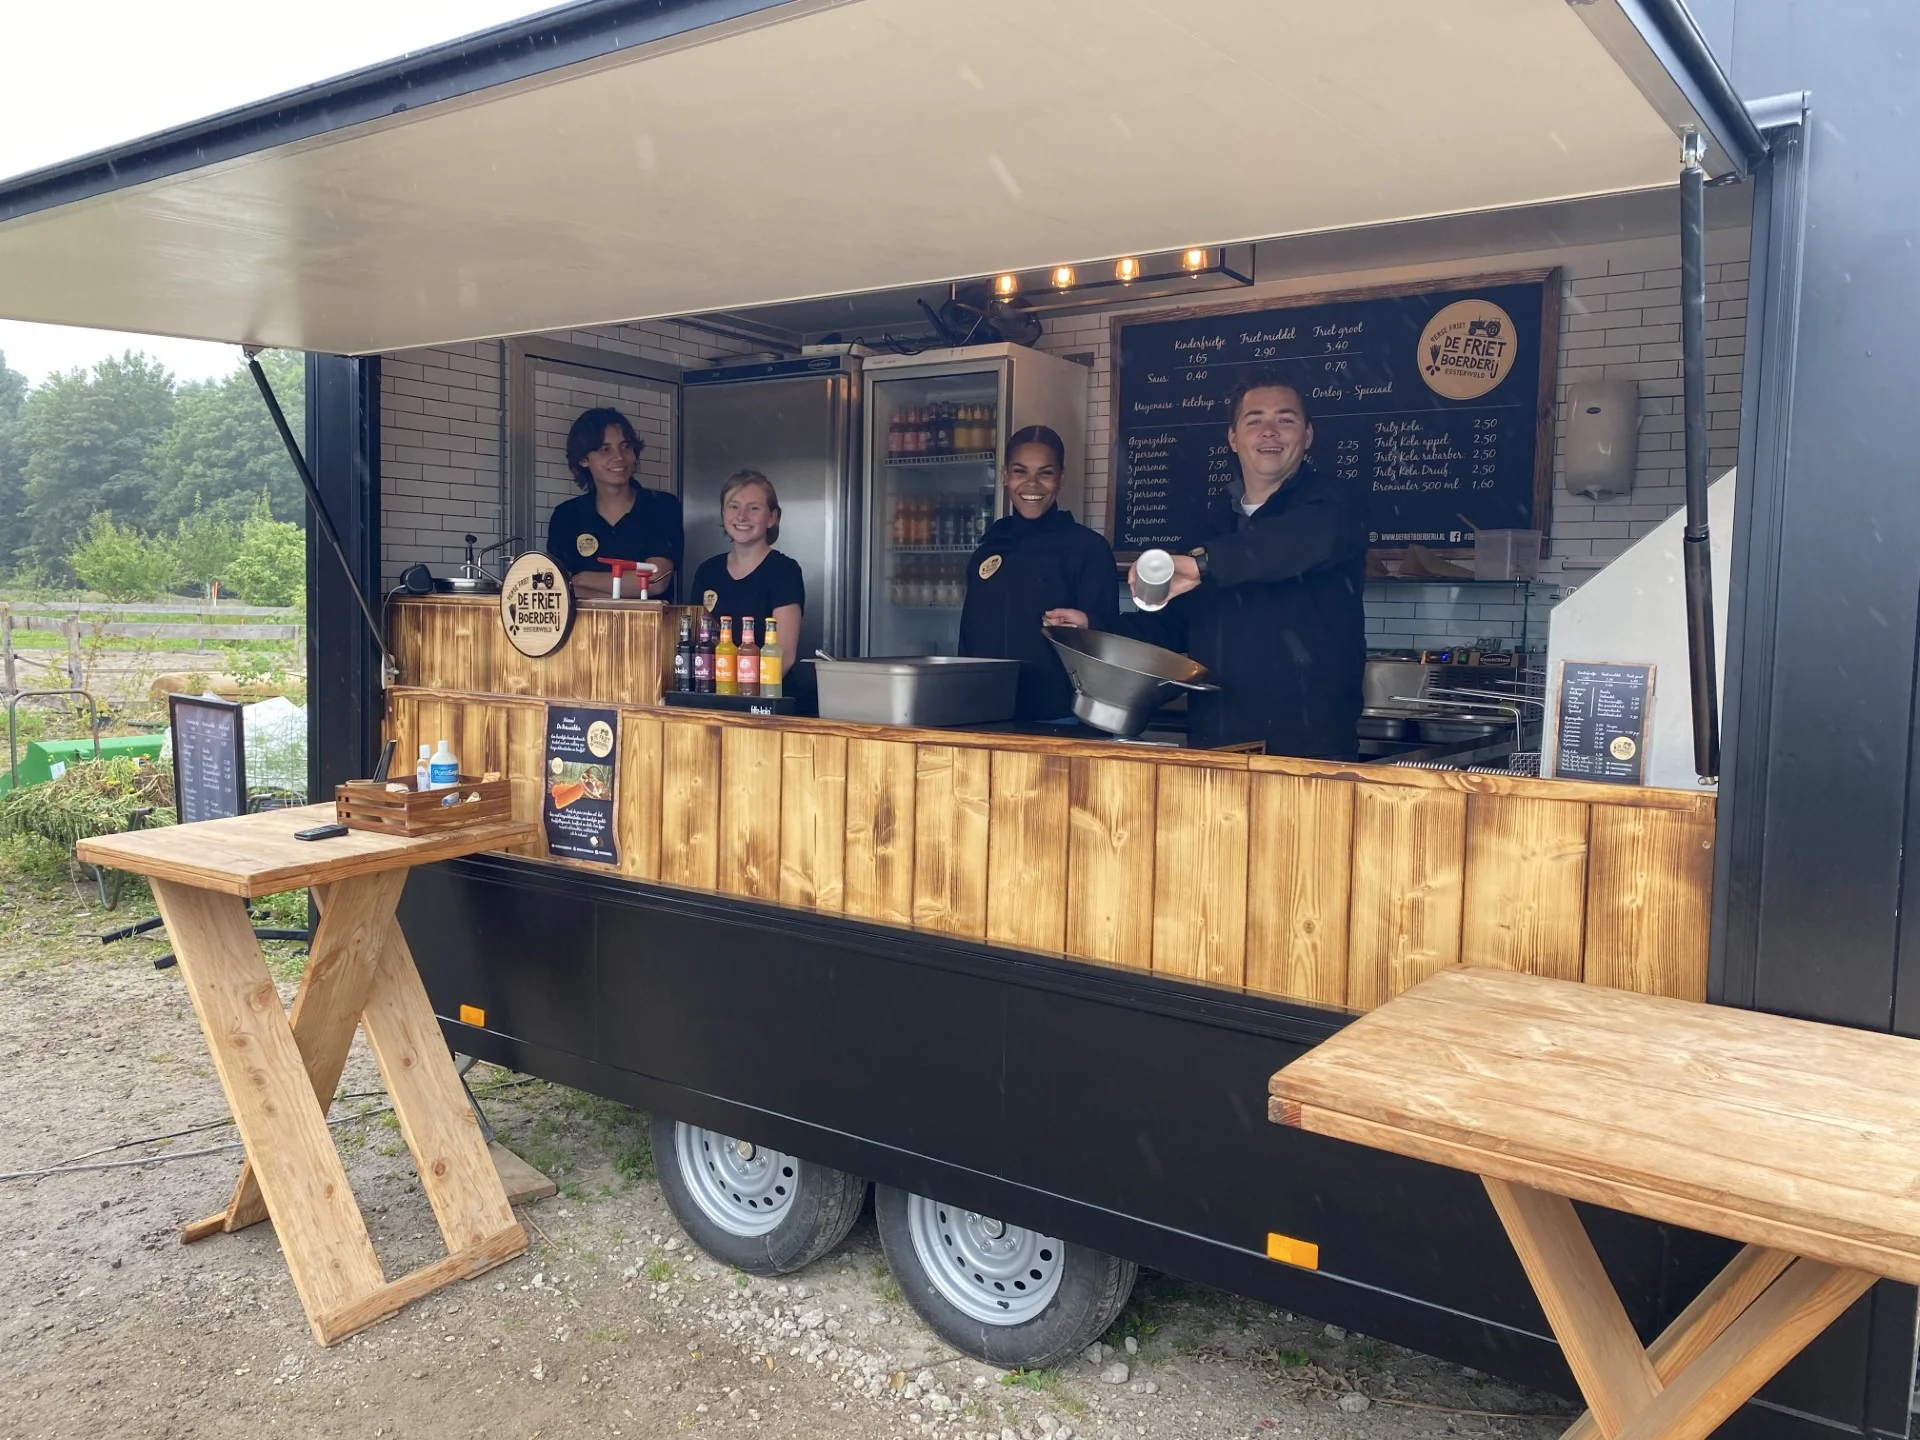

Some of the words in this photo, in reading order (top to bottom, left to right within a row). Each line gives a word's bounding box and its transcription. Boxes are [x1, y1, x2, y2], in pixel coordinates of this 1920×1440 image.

[1239, 330, 1263, 344] Friet
[1263, 326, 1297, 341] middel
[1312, 323, 1337, 338] Friet
[1338, 321, 1364, 339] groot
[1430, 326, 1450, 342] VERSE
[1449, 322, 1466, 330] FRIET
[1174, 335, 1227, 351] Kinderfrietje
[1443, 335, 1462, 349] DE
[1132, 401, 1174, 415] Mayonaise
[1182, 394, 1216, 411] Ketchup
[1312, 384, 1343, 401] Oorlog
[1353, 381, 1393, 401] Speciaal
[1374, 421, 1399, 437] Fritz
[1374, 437, 1398, 451] Fritz
[1400, 434, 1421, 447] Kola
[1128, 450, 1134, 459] 2
[1373, 452, 1397, 466] Fritz
[1399, 449, 1420, 461] Kola
[1127, 464, 1133, 474] 3
[1373, 466, 1396, 480] Fritz
[1398, 463, 1419, 476] Kola
[1127, 477, 1133, 486] 4
[1372, 480, 1420, 492] Bronwater
[1420, 481, 1442, 492] 500
[1126, 490, 1133, 501] 5
[1126, 503, 1133, 512] 6
[1126, 516, 1133, 525] 8
[1124, 533, 1150, 548] Sauzen
[517, 592, 529, 606] DE
